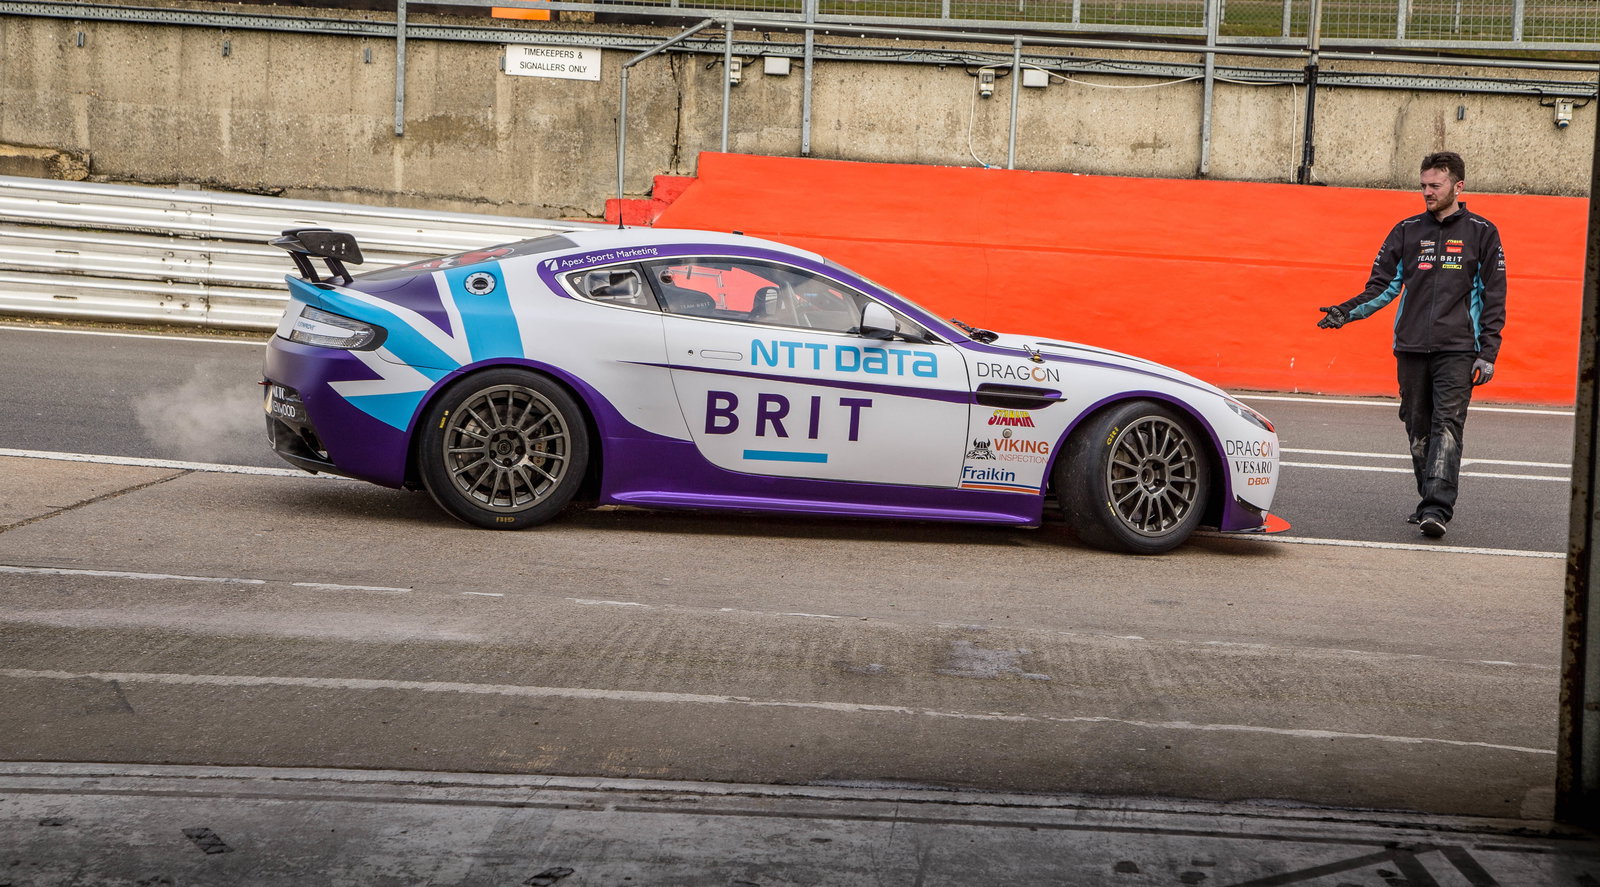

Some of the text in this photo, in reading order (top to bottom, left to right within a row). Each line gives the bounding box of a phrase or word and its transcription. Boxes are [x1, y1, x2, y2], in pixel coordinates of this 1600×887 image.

[523, 48, 575, 59] TIMEKEEPERS
[519, 61, 587, 73] SIGNALLERS ONLY
[561, 247, 659, 268] Apex Sports Marketing
[751, 338, 828, 371] NTT
[976, 362, 1060, 382] DRAGON
[272, 400, 296, 418] ENWOOD
[704, 390, 873, 441] BRIT
[993, 438, 1049, 455] VIKING
[1225, 440, 1274, 457] DRAGON
[998, 453, 1048, 465] INSPECTION
[1235, 460, 1272, 474] VESARO
[962, 466, 1015, 482] Fraikin
